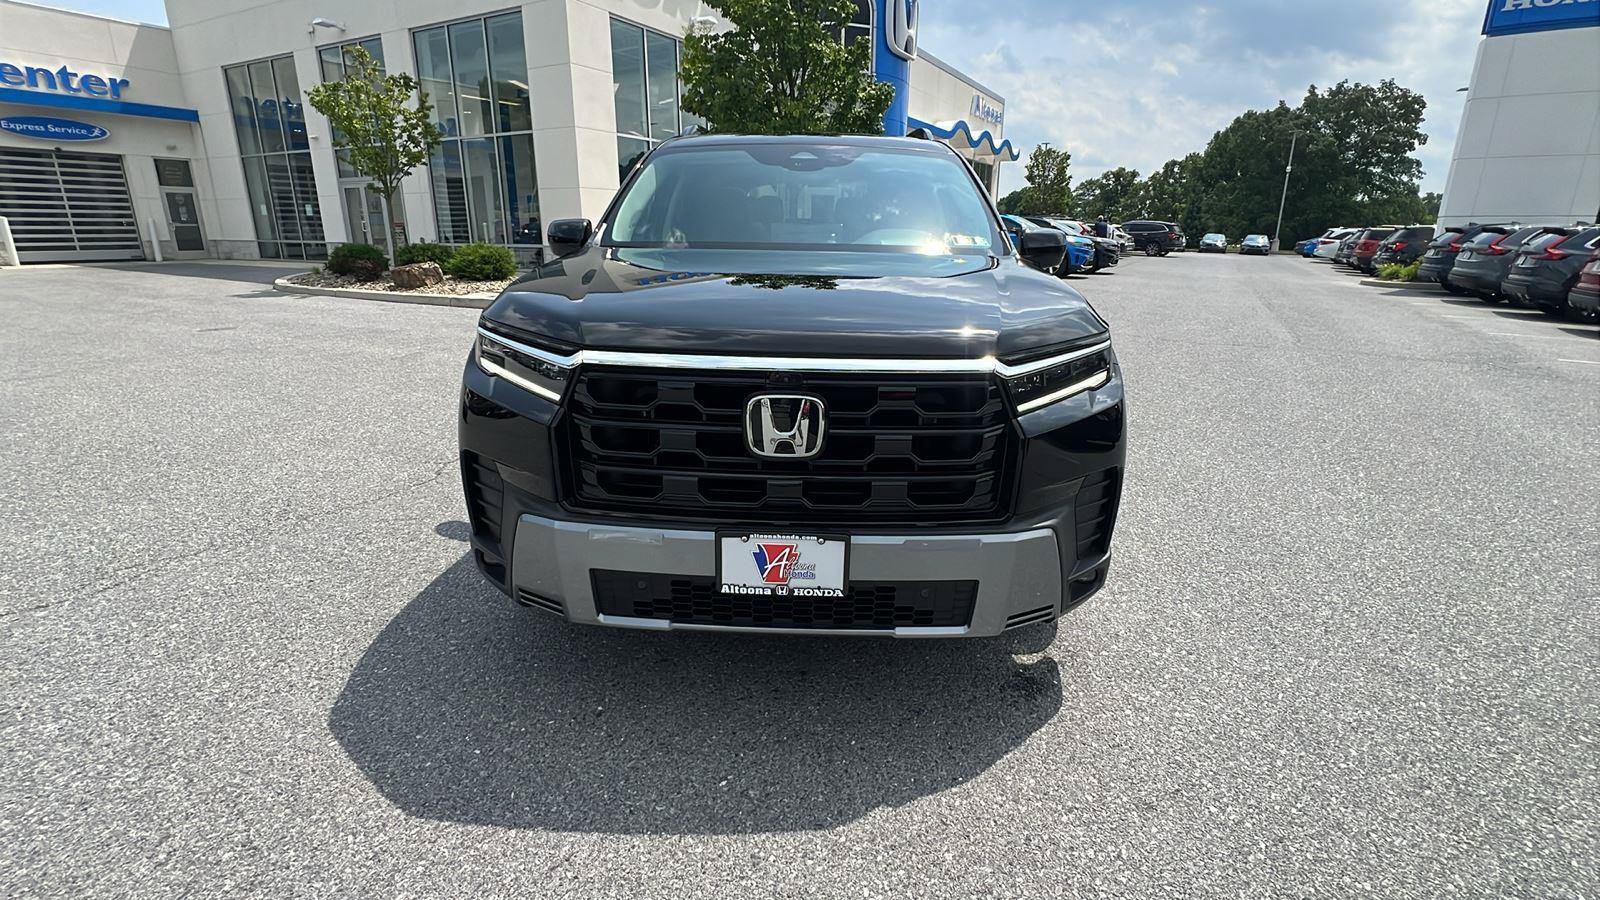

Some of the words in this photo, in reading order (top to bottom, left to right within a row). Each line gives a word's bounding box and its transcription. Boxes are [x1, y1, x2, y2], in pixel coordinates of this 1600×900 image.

[1, 120, 45, 133] Express
[47, 125, 88, 135] Service
[783, 569, 814, 578] Honda
[720, 585, 772, 595] Altoona
[793, 588, 844, 597] HONDA
